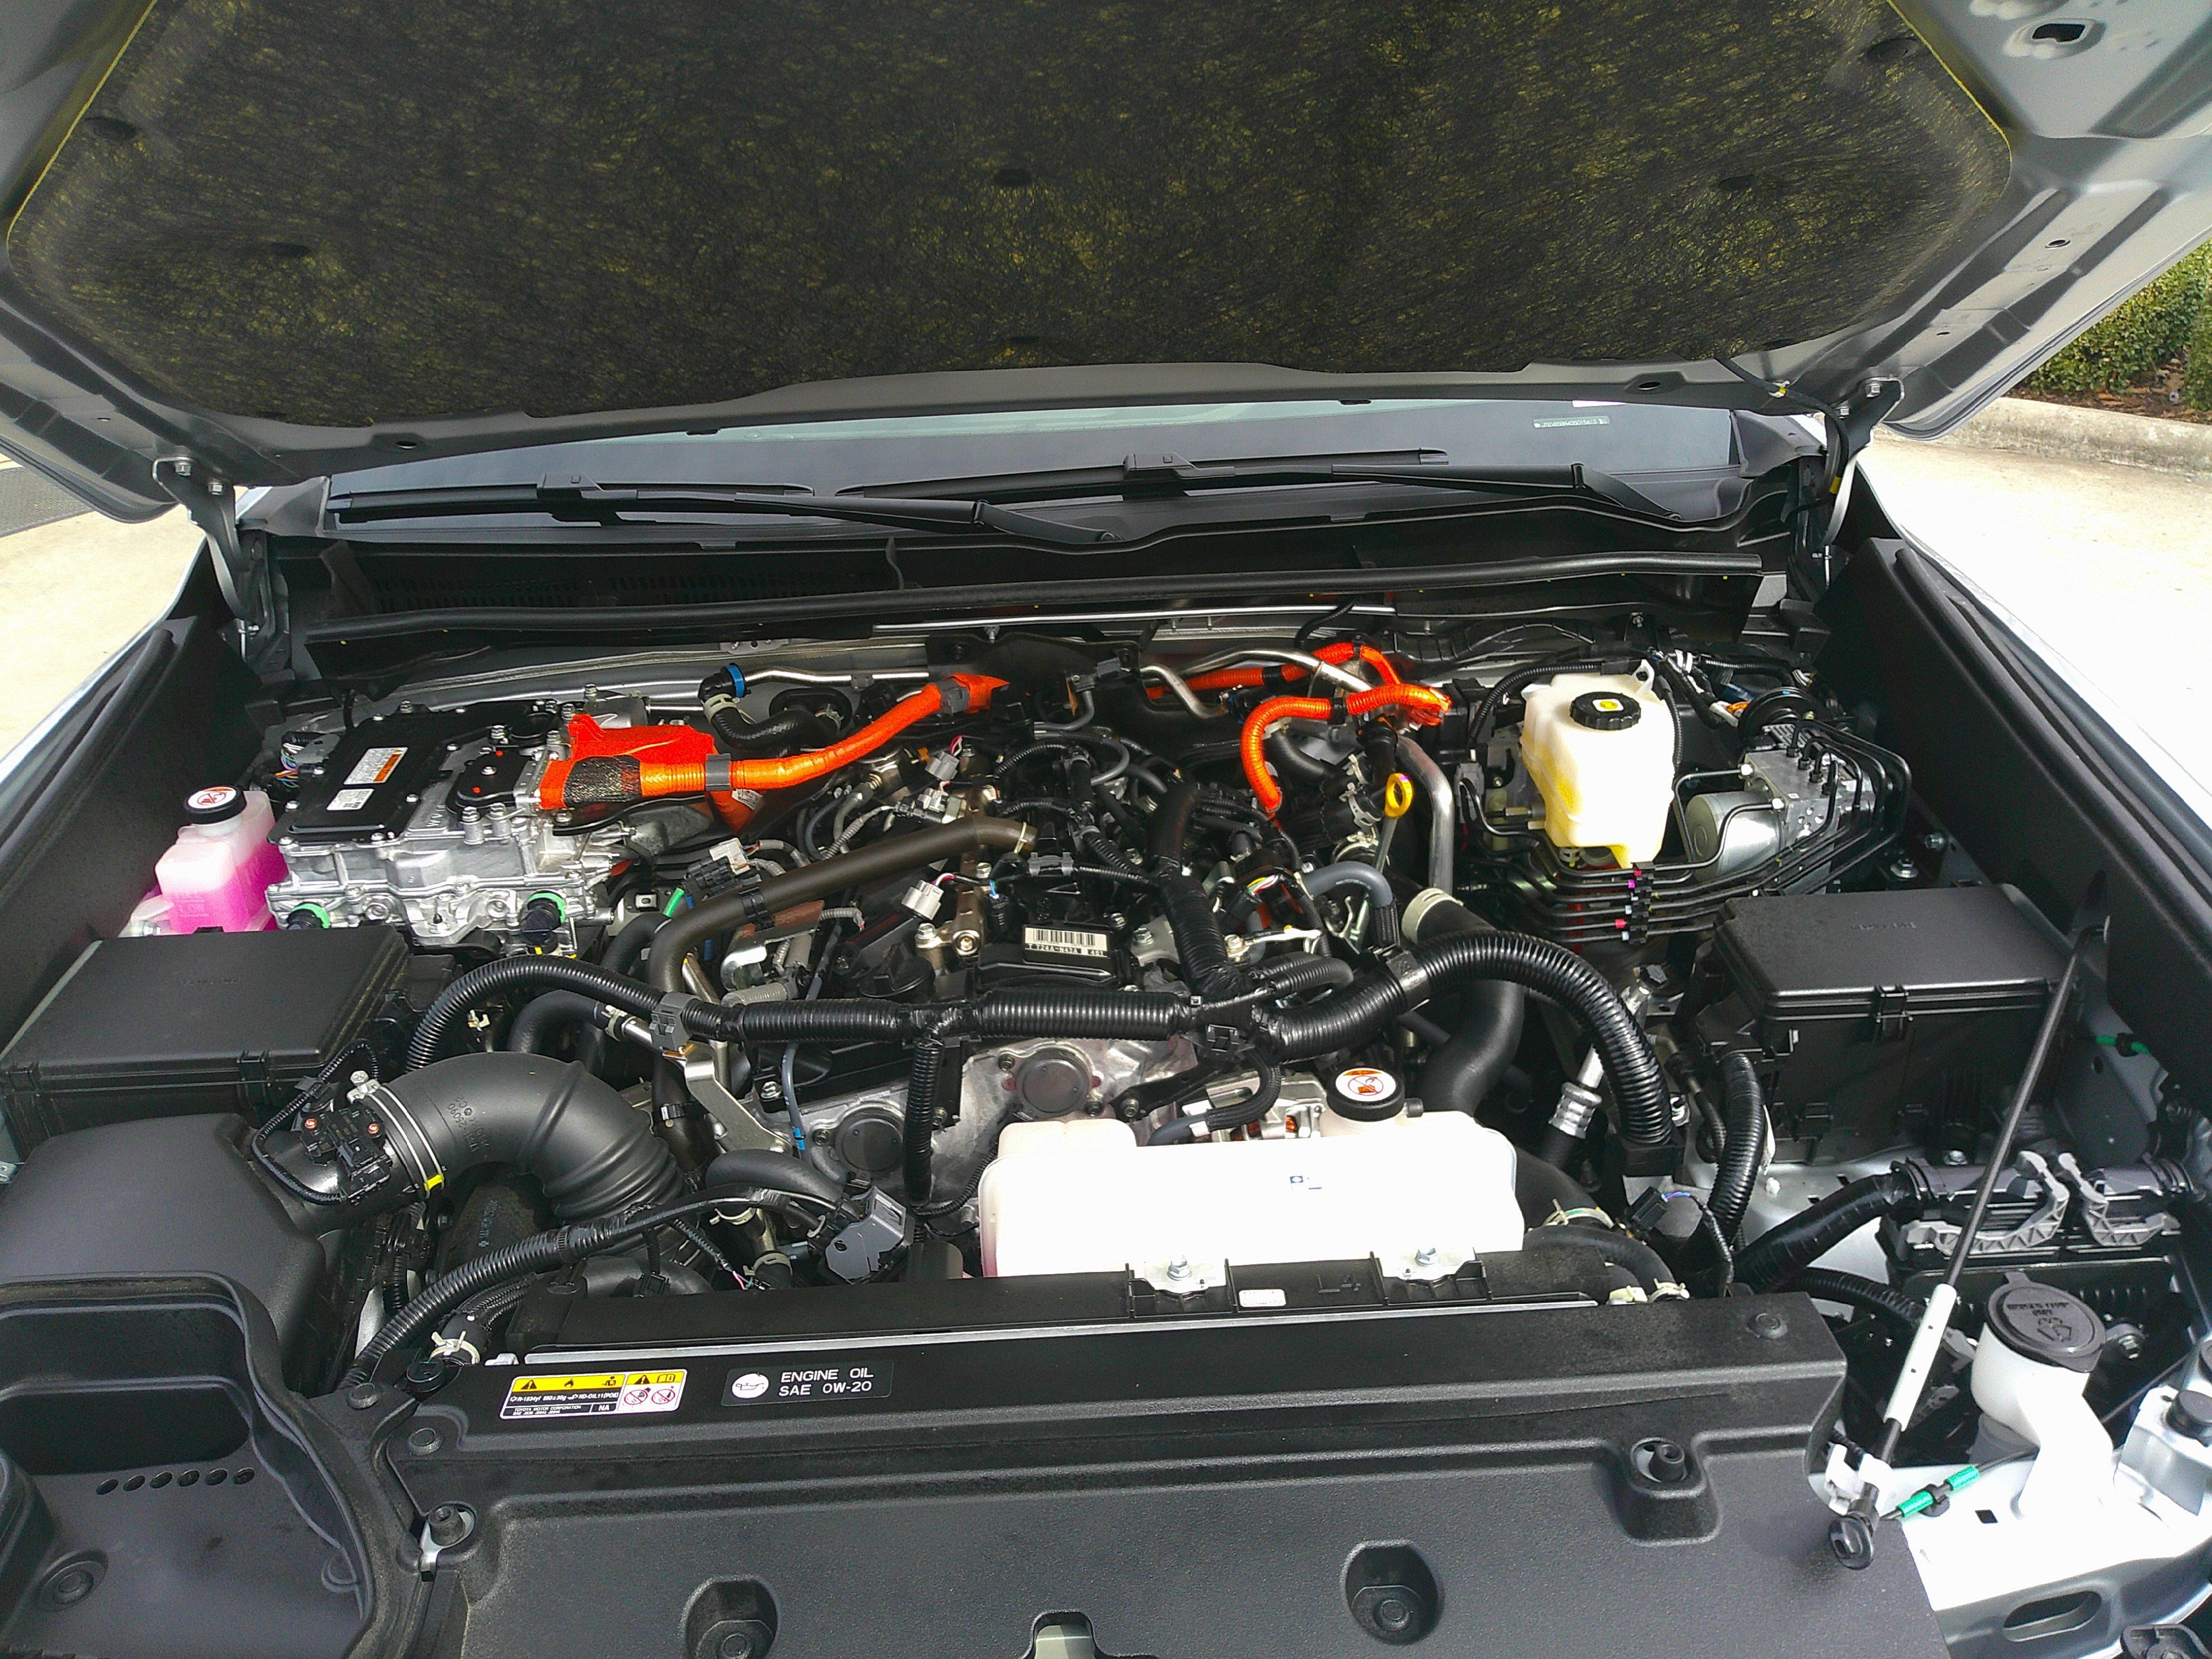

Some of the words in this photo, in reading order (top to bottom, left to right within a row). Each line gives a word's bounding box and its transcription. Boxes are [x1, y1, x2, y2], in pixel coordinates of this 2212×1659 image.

[780, 1369, 839, 1383] ENGINE
[849, 1368, 874, 1379] OIL
[778, 1384, 812, 1397] SAE
[822, 1381, 872, 1394] 0W-20
